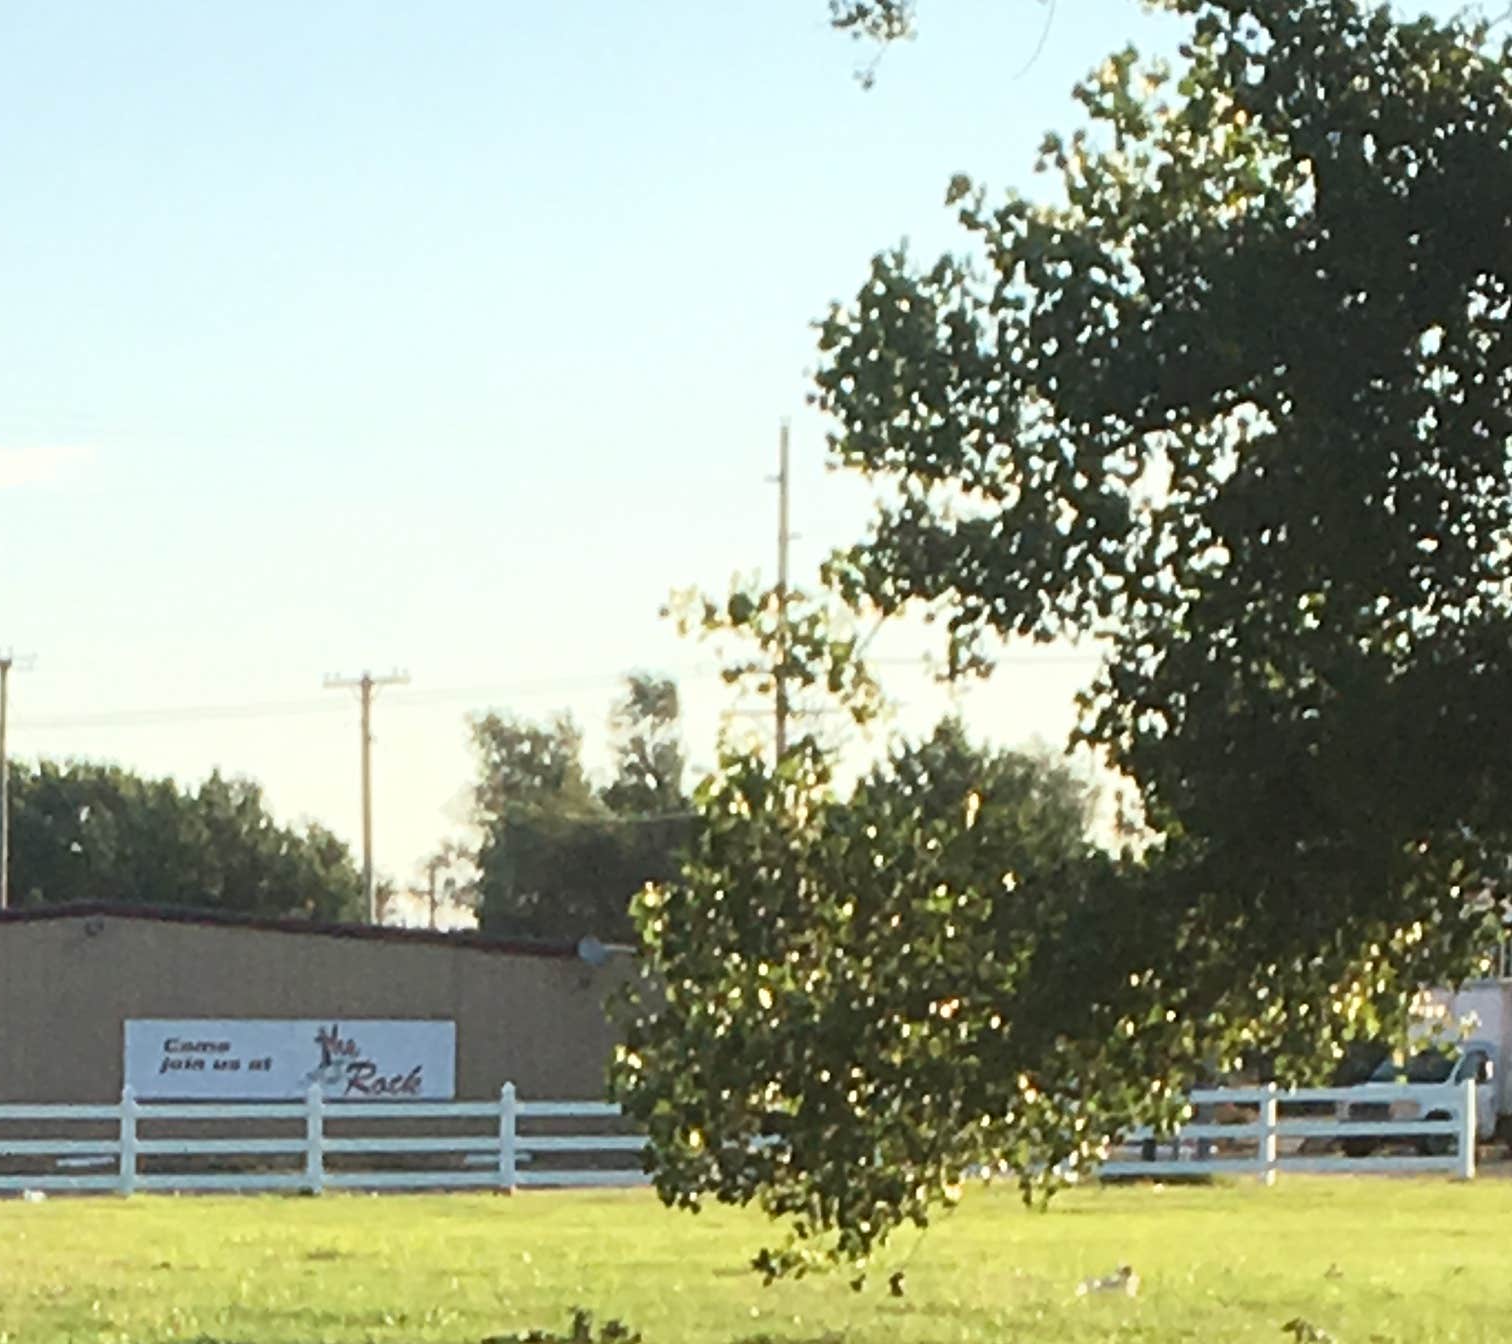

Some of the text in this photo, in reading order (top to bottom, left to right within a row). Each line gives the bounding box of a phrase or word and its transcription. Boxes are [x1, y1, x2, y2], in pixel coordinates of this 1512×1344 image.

[163, 1037, 231, 1054] Come
[159, 1056, 272, 1074] join us at
[344, 1061, 423, 1096] Rock
